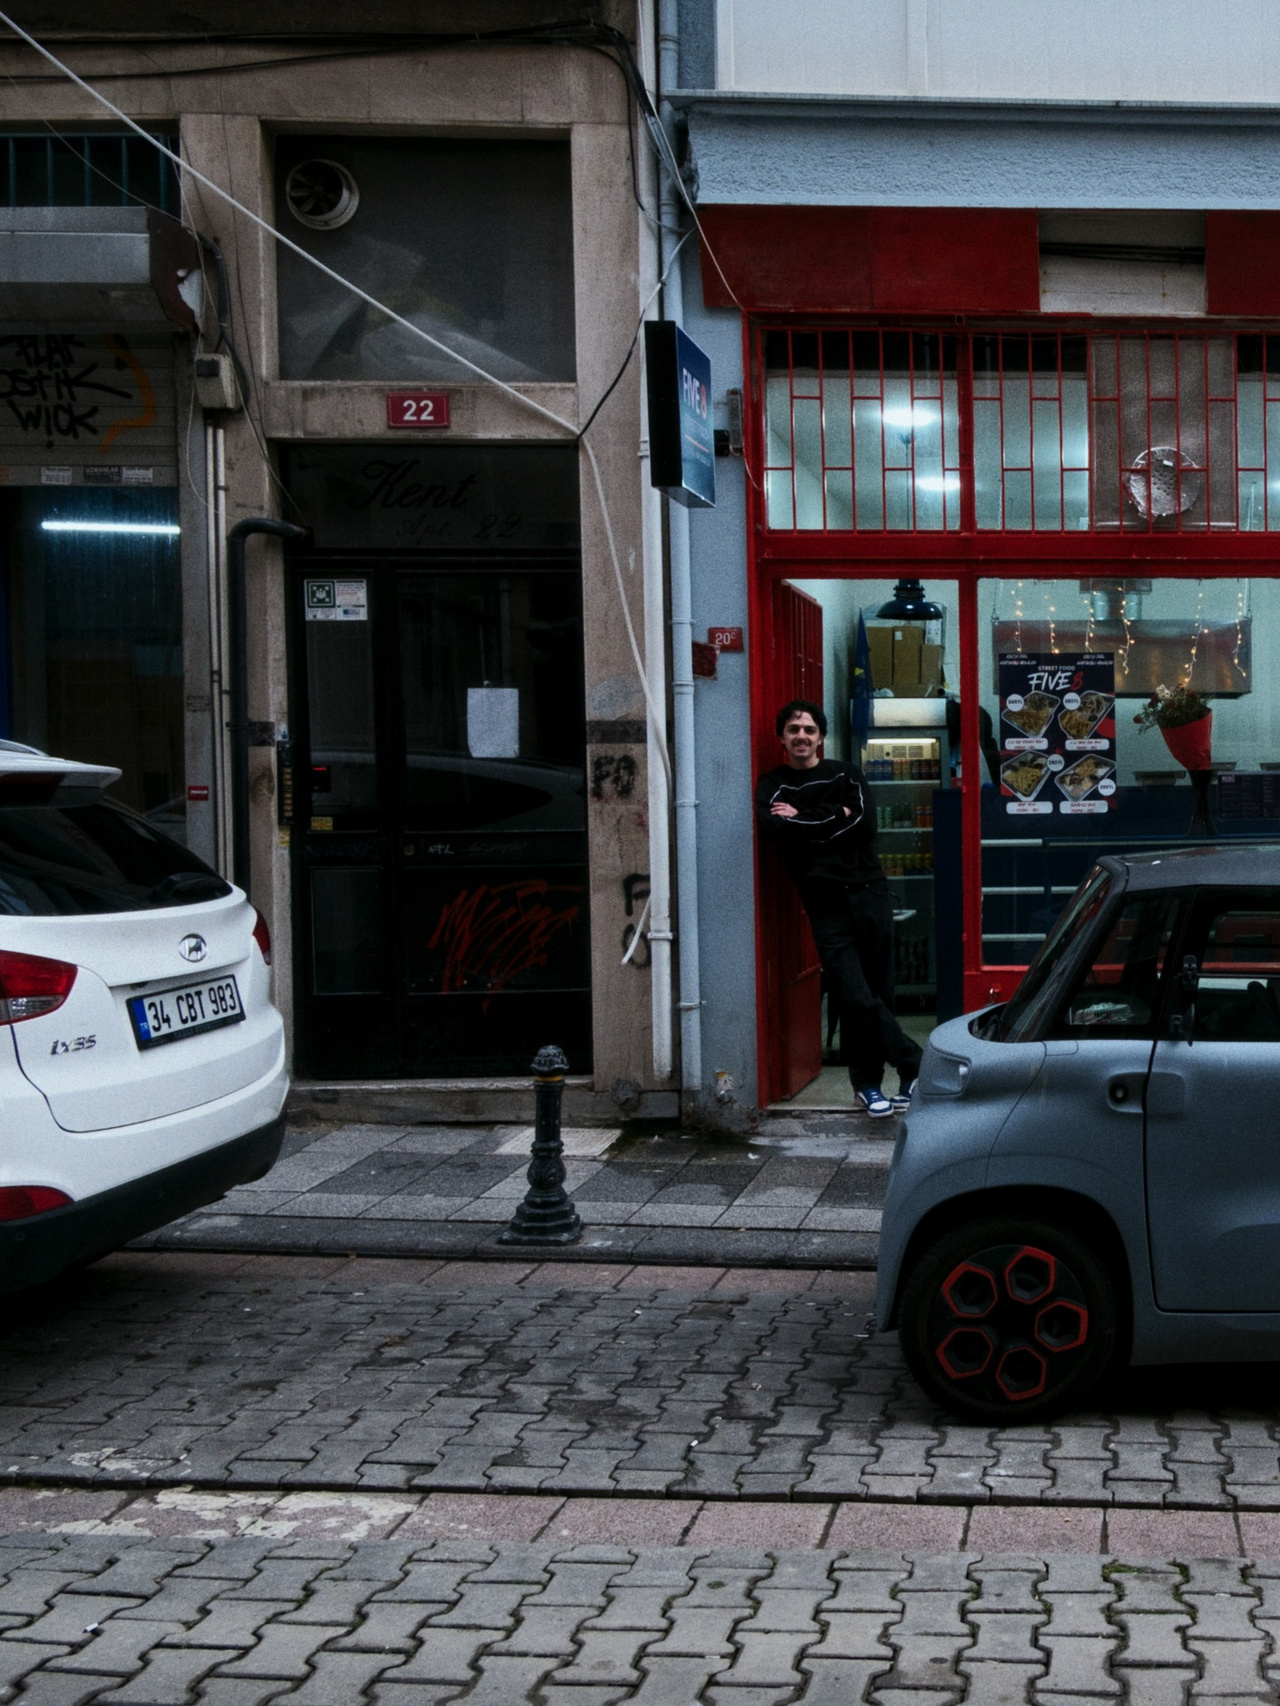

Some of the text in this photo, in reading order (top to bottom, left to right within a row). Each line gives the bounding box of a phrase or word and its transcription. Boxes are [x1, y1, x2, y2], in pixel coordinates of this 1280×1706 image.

[403, 399, 435, 421] 22
[346, 459, 478, 510] Kent
[148, 1000, 172, 1033] 34
[176, 991, 206, 1026] CBT
[208, 983, 237, 1016] 983
